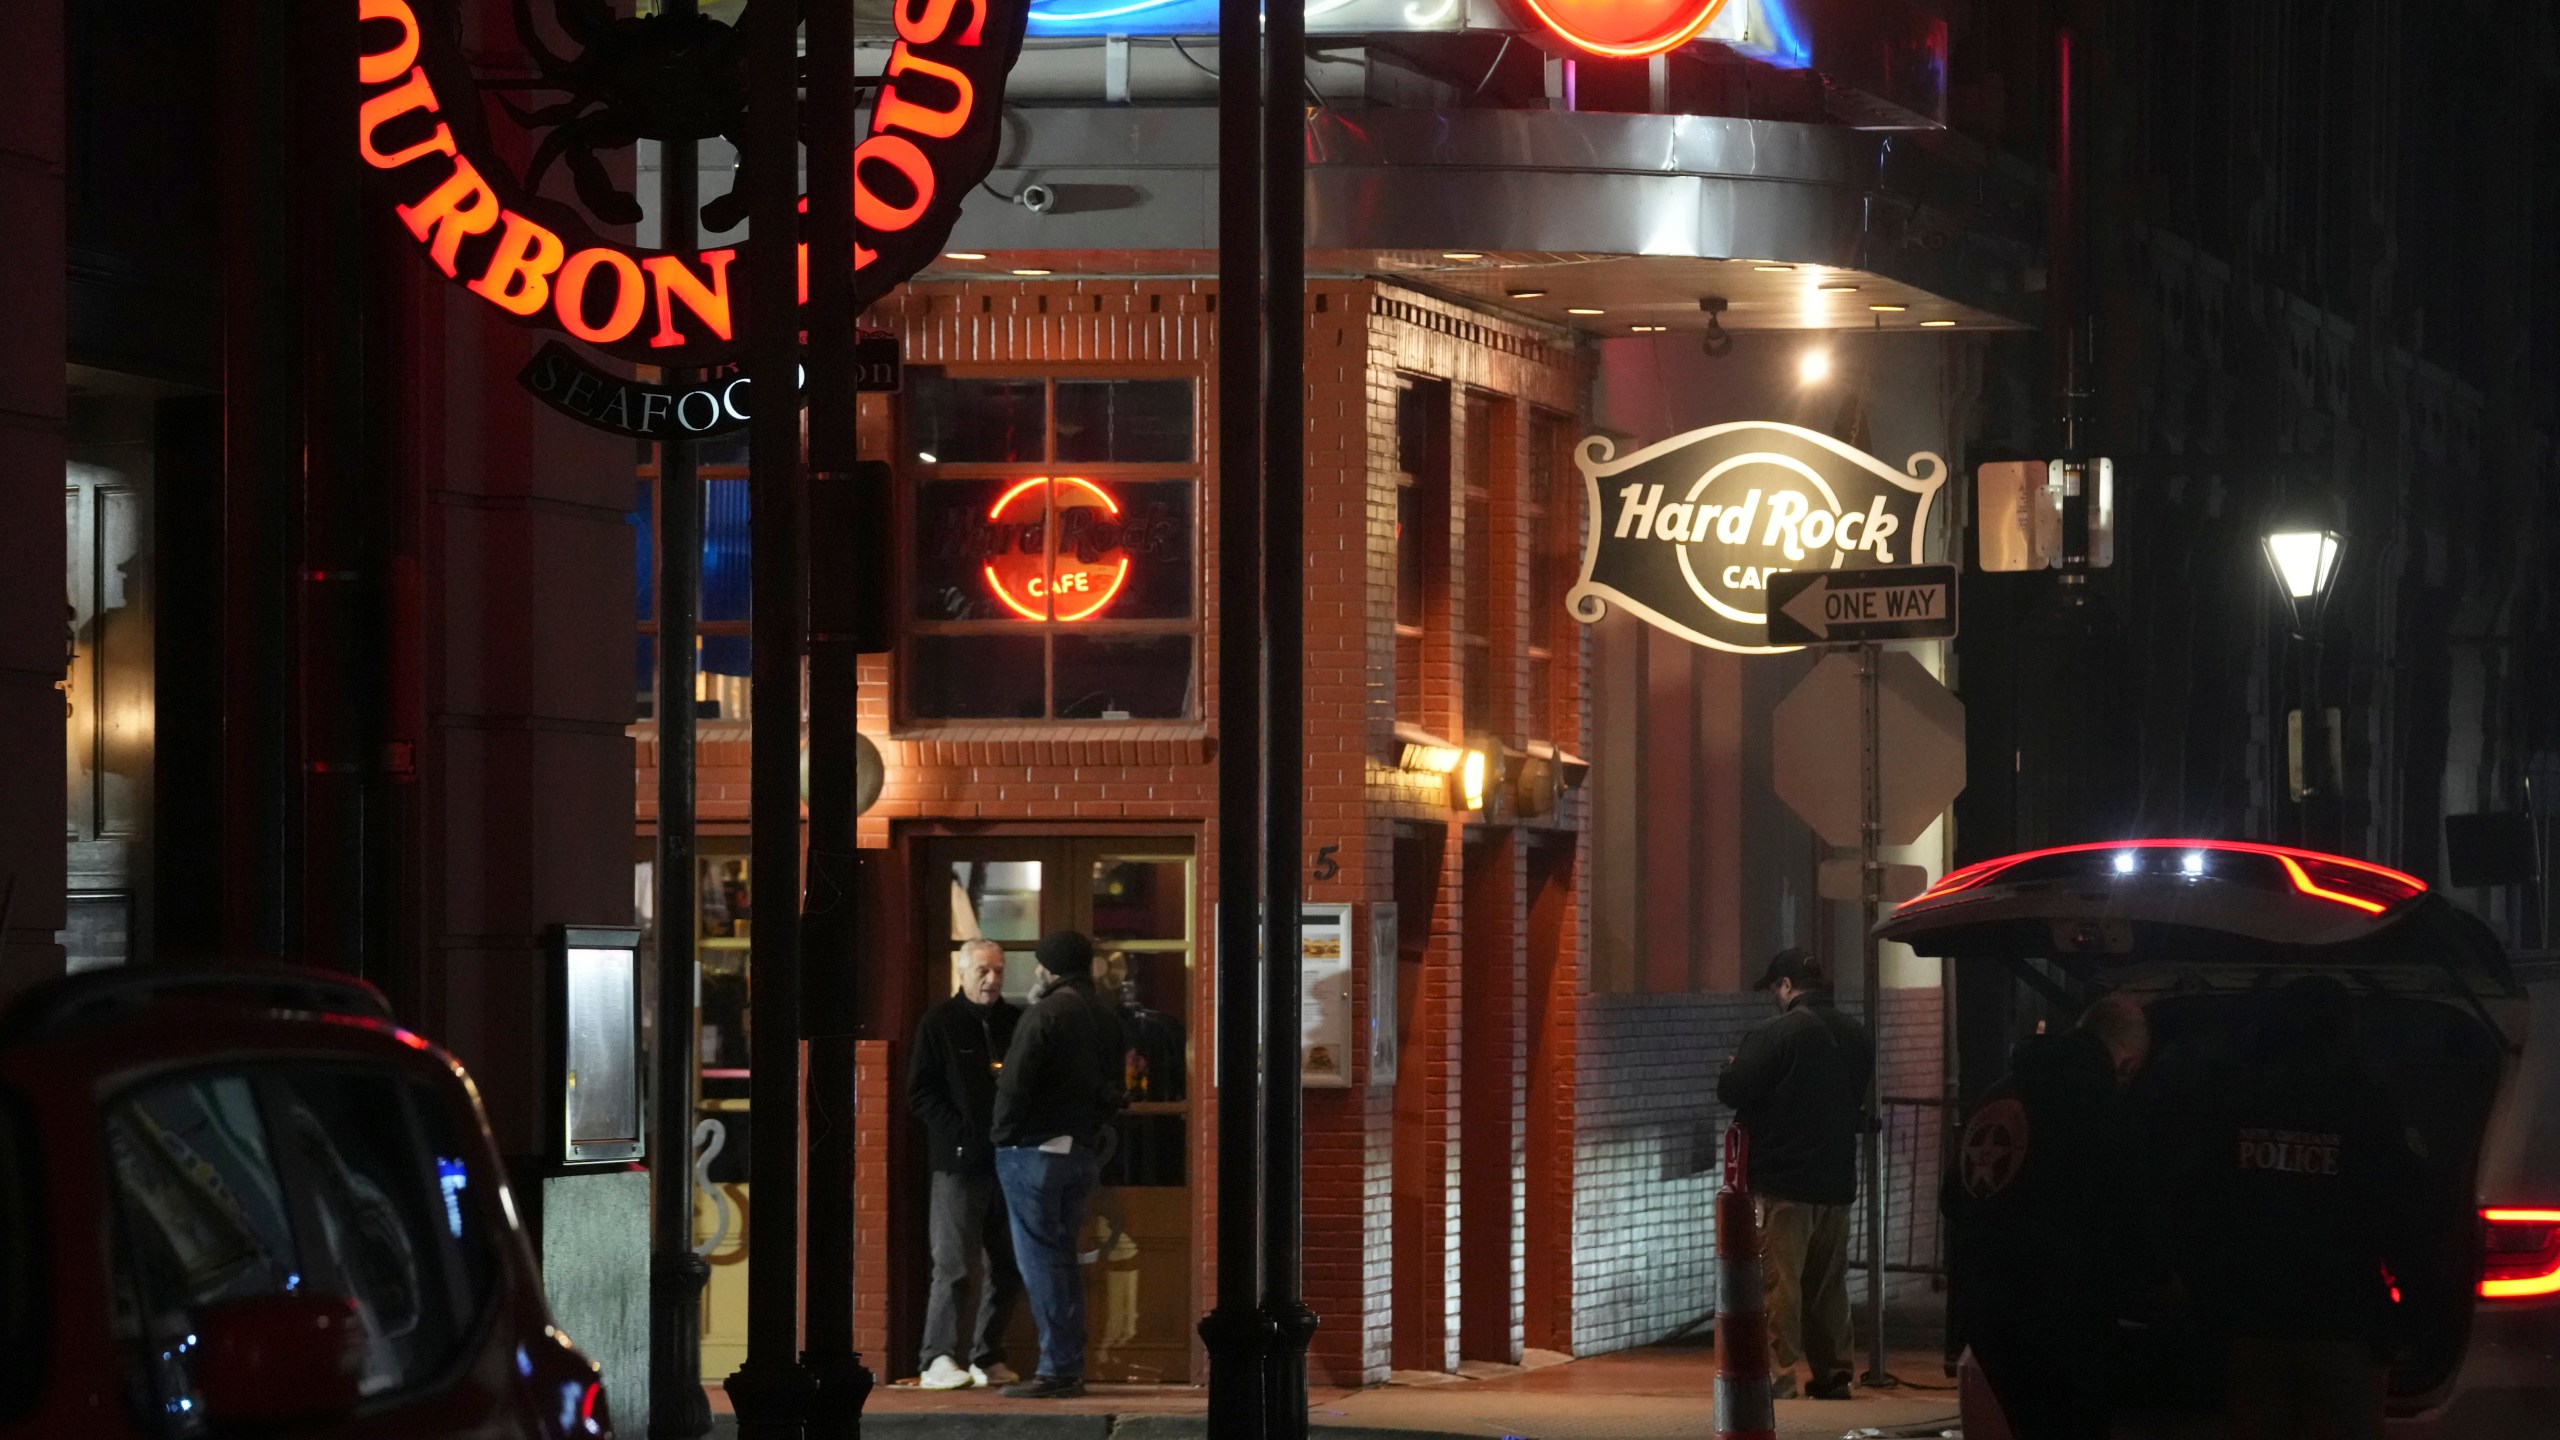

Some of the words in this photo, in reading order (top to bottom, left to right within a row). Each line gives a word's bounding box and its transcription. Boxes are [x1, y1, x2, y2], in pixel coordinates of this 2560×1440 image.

[531, 354, 806, 433] SEAFOO
[1613, 483, 1761, 544] Hard
[1762, 490, 1899, 563] Rock
[1027, 572, 1089, 597] CAFE
[1825, 592, 1877, 620] ONE
[1886, 588, 1936, 617] WAY
[1313, 846, 1339, 881] 5
[2239, 1140, 2341, 1176] POLICE
